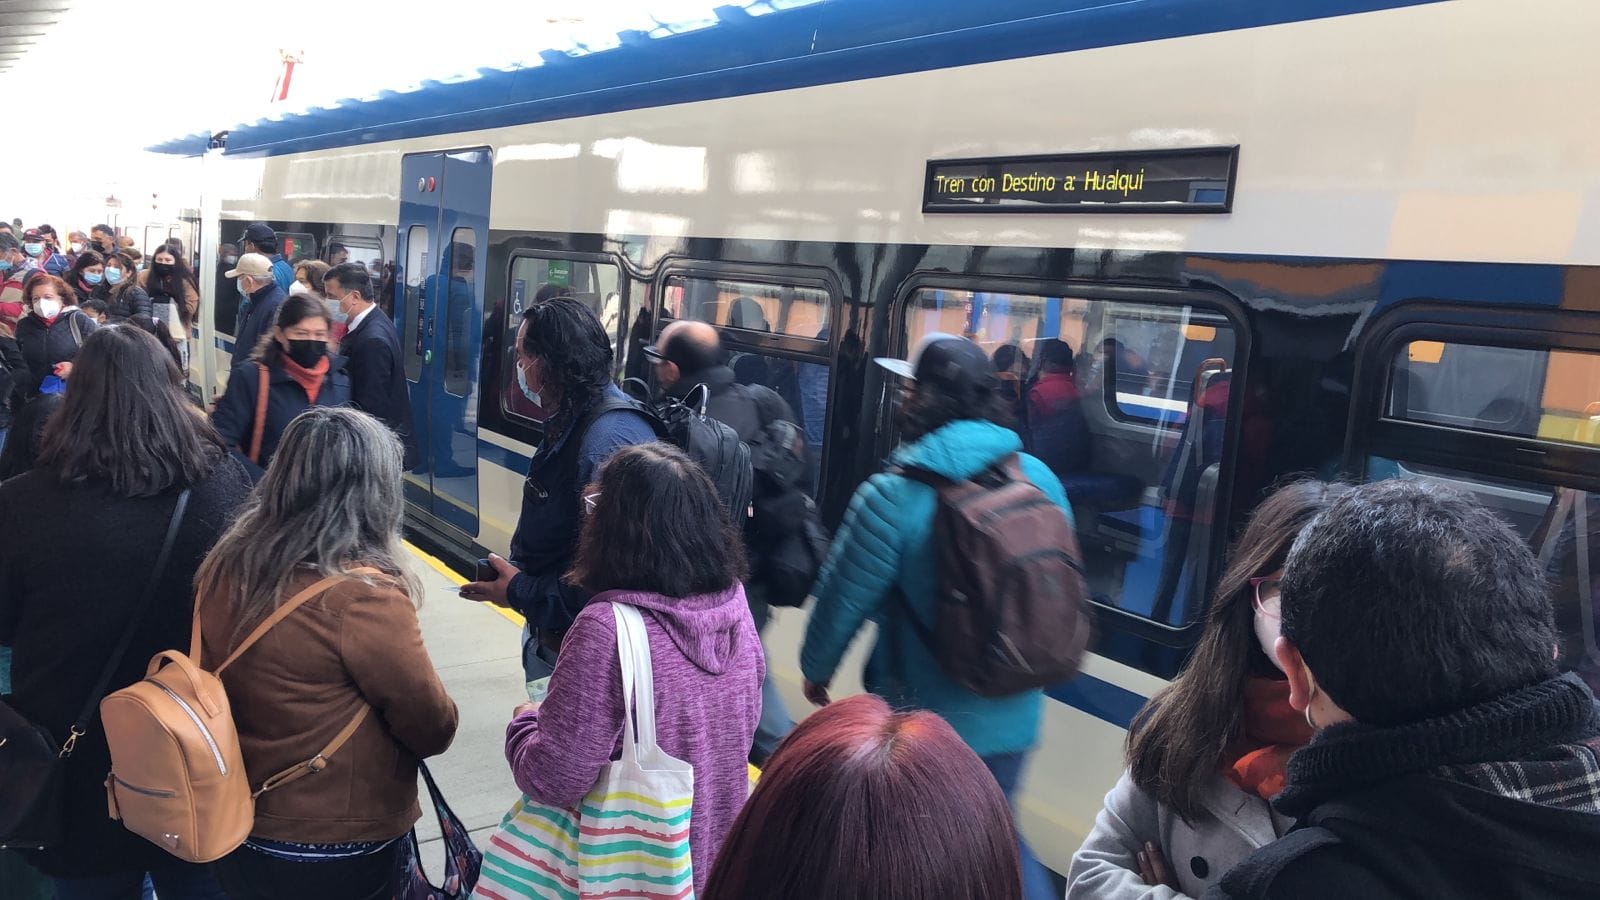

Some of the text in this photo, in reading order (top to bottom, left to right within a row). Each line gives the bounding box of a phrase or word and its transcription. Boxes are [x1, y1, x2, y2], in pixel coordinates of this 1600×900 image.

[936, 175, 965, 193] Tren
[971, 176, 995, 192] con
[1001, 171, 1056, 192] Destino
[1084, 168, 1145, 197] Hualqui
